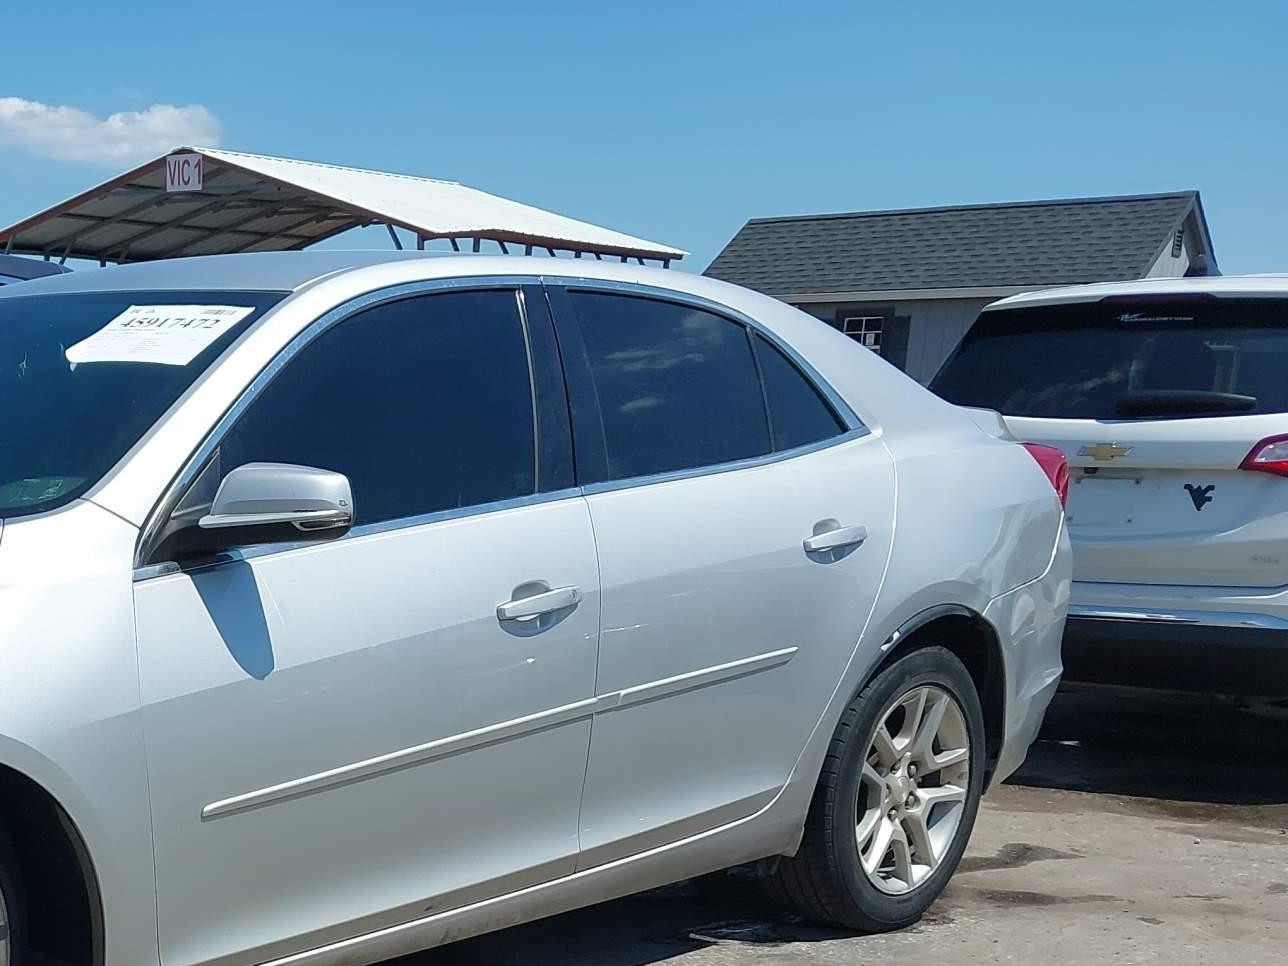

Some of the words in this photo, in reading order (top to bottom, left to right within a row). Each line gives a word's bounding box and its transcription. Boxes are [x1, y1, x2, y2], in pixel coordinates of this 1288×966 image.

[167, 159, 191, 186] VIC
[194, 158, 201, 185] 1
[120, 316, 221, 329] 45917472
